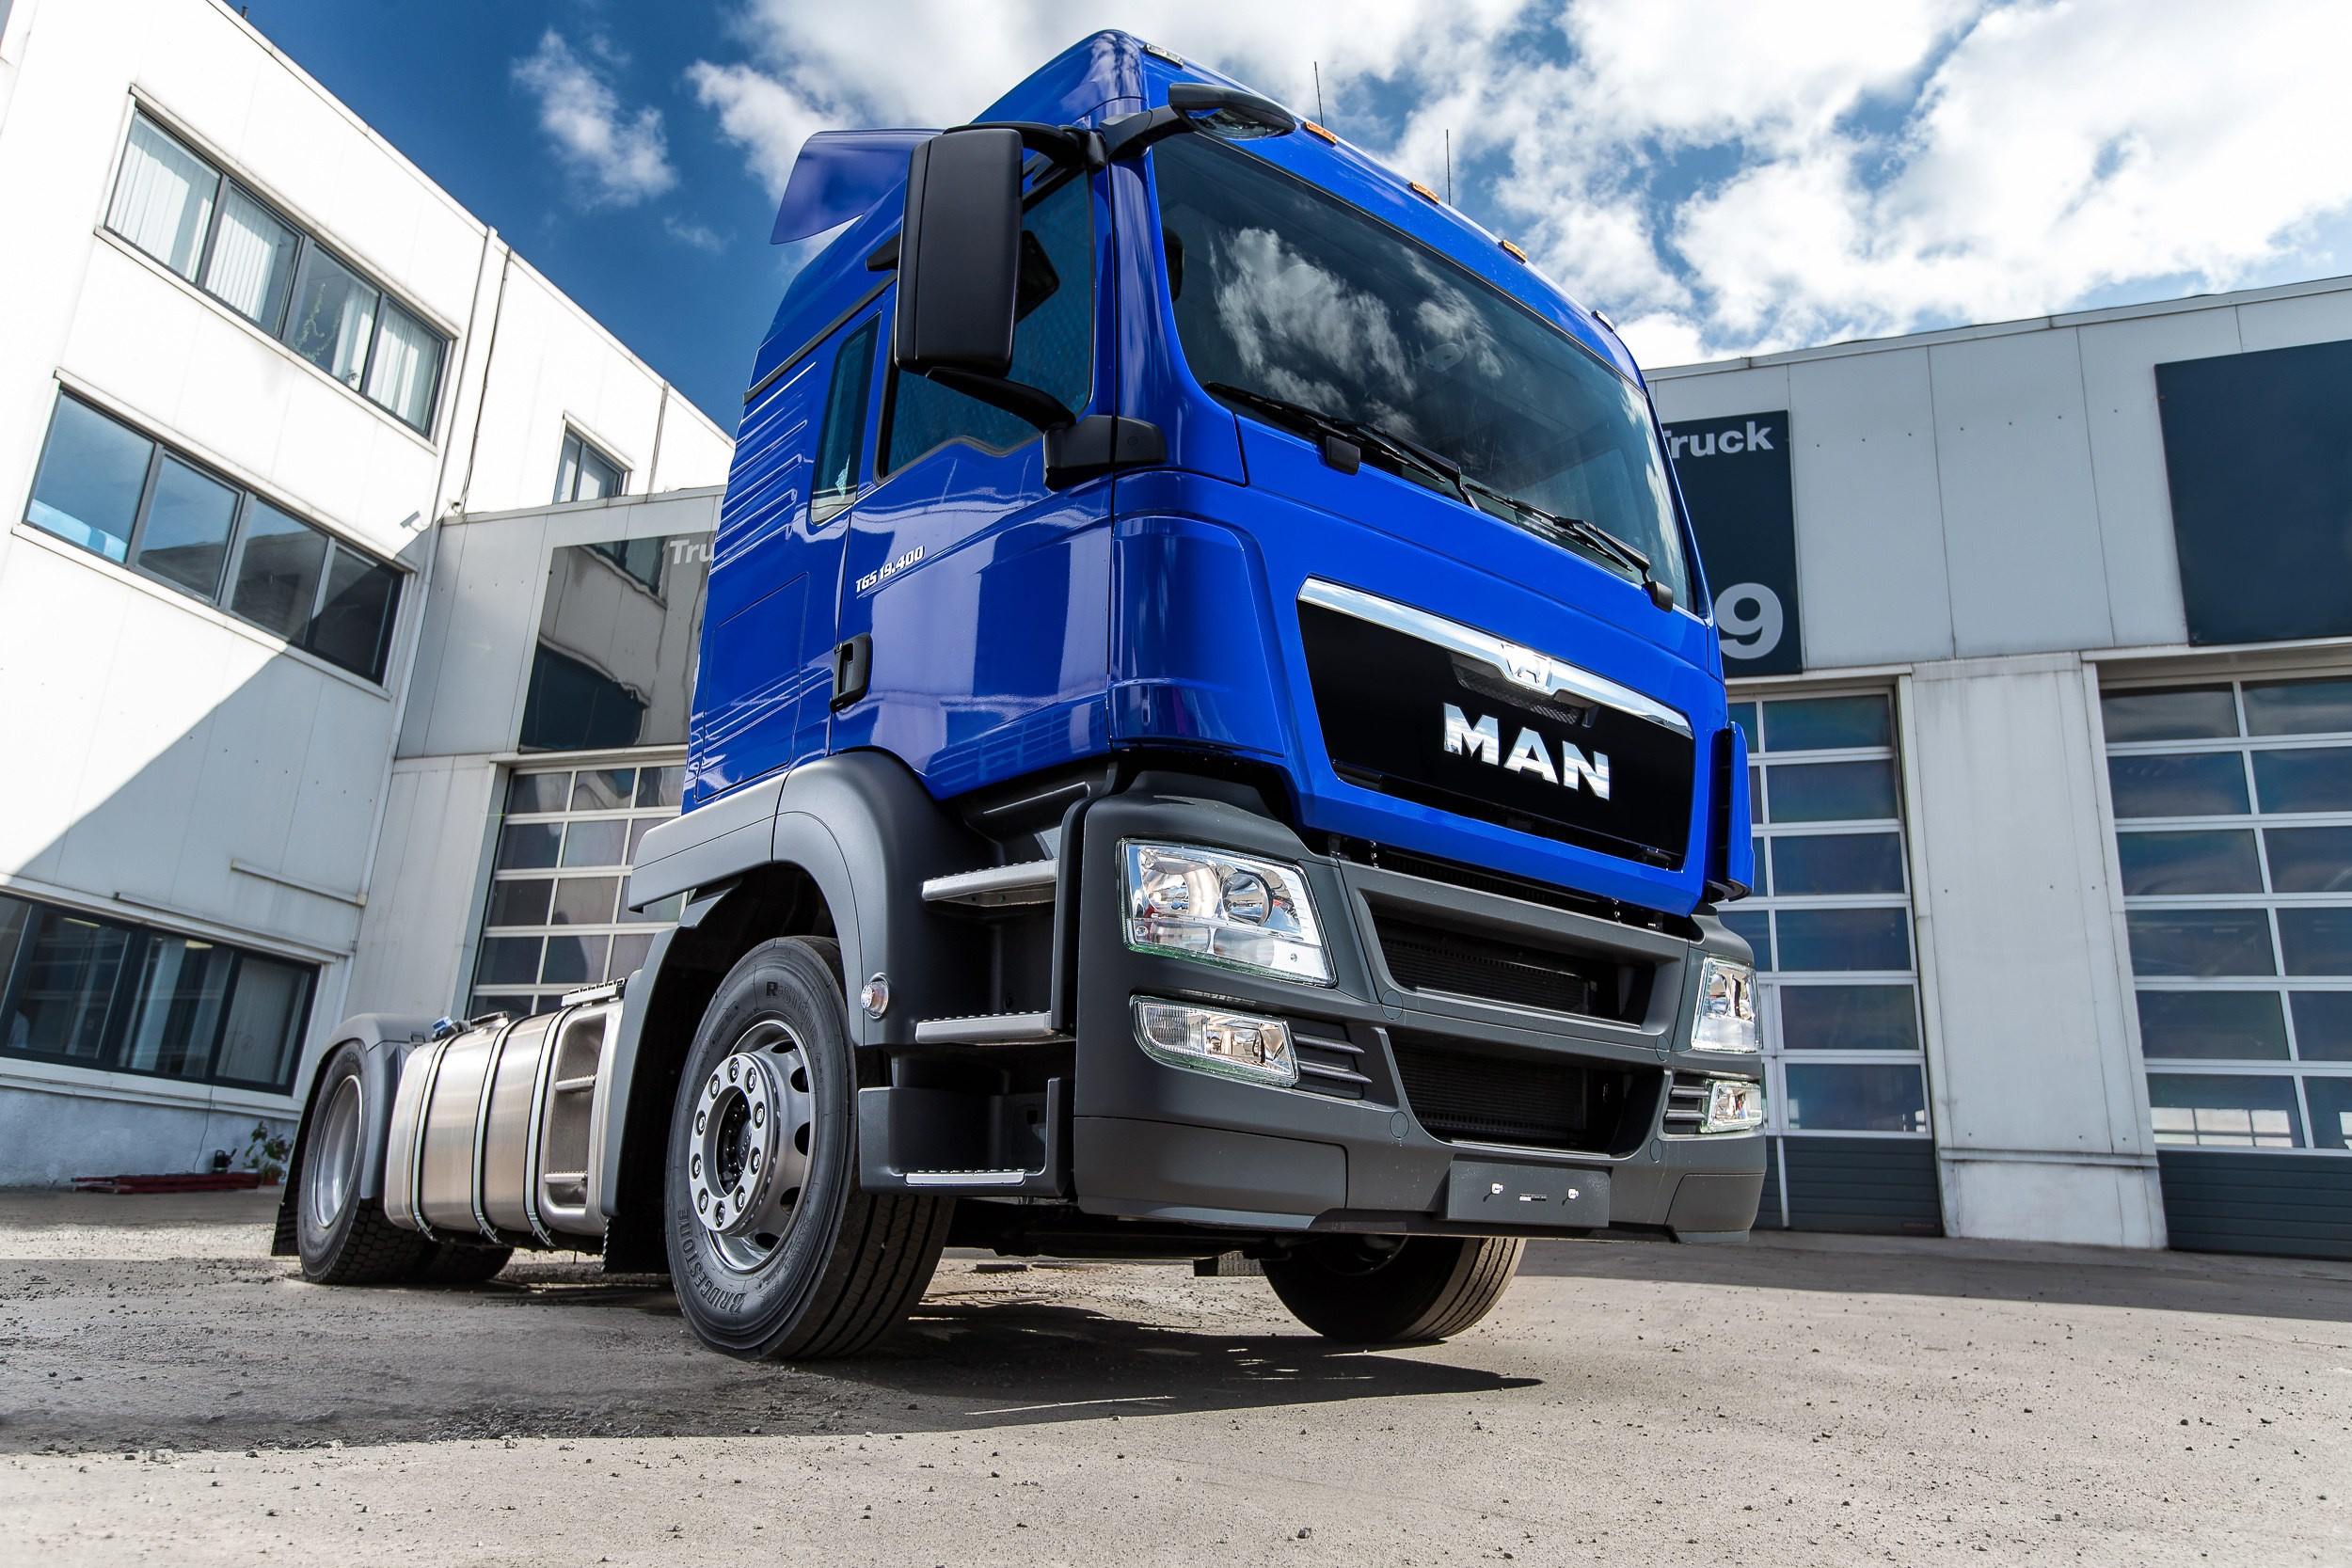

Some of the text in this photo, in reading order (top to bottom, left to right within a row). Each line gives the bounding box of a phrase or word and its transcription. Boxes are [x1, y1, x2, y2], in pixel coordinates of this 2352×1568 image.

[855, 545, 926, 594] TGS 19.400
[1714, 582, 1784, 659] 9
[1443, 702, 1610, 801] MAN
[677, 1206, 749, 1316] BRIDGESTONE
